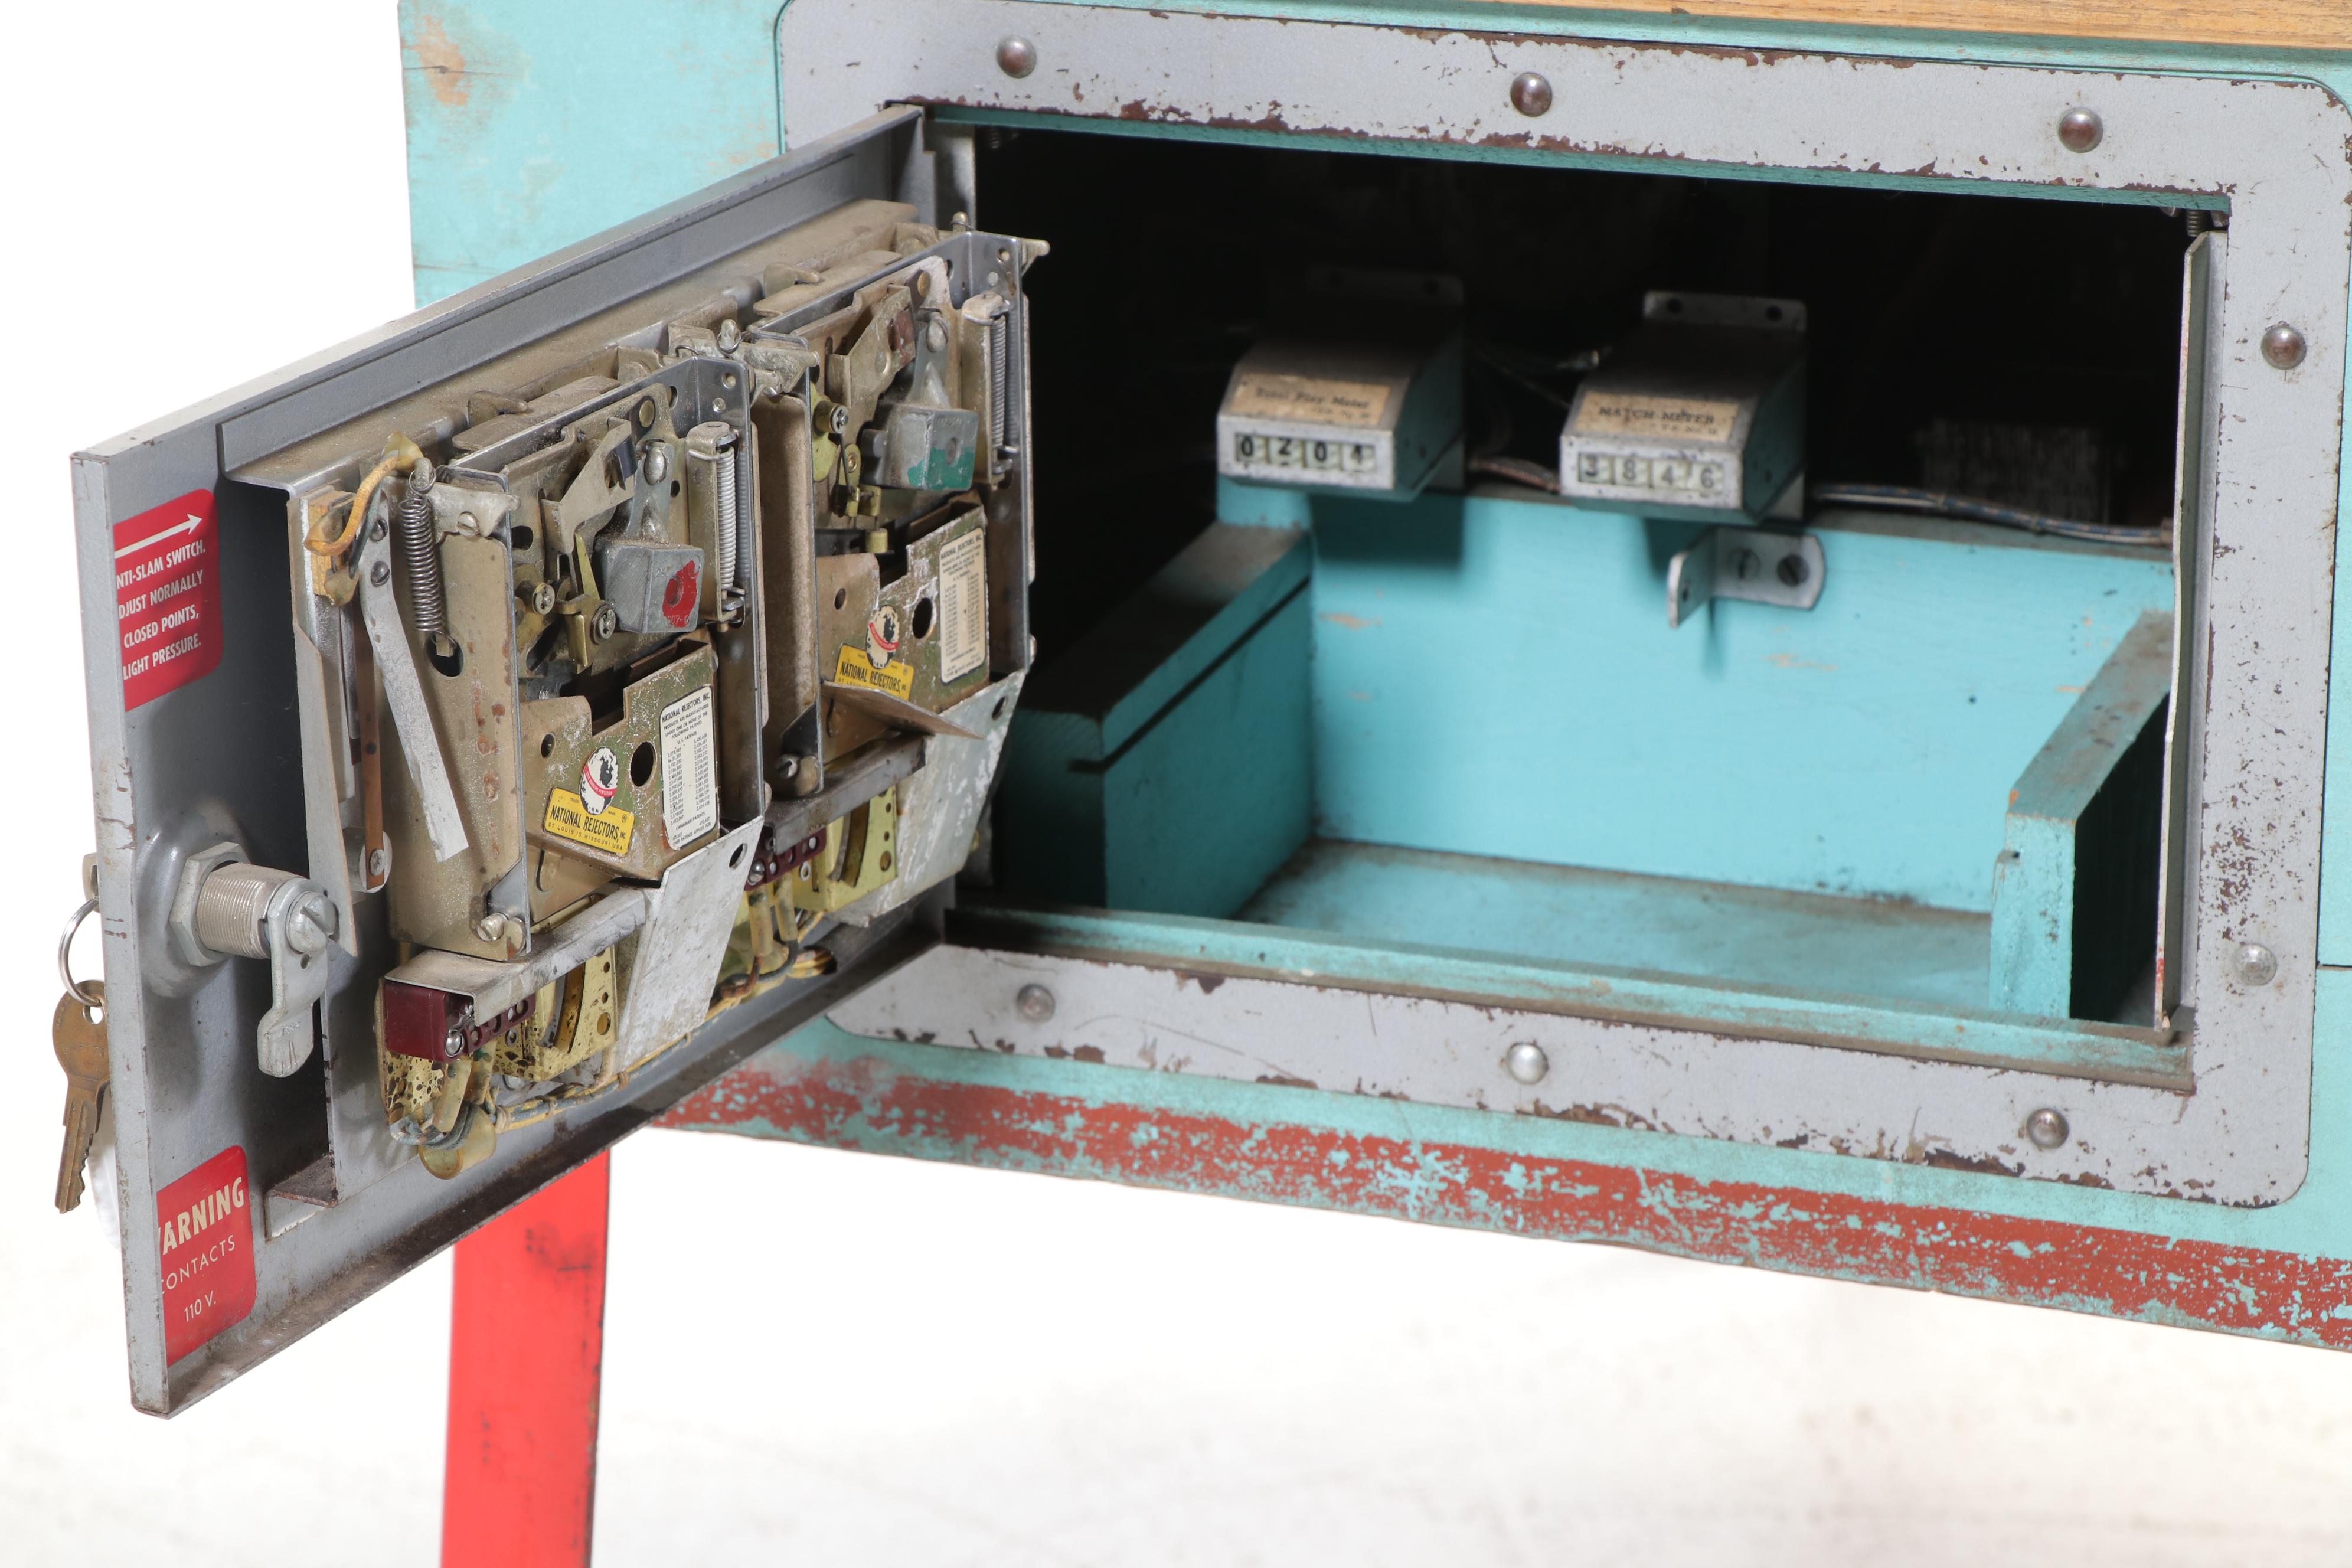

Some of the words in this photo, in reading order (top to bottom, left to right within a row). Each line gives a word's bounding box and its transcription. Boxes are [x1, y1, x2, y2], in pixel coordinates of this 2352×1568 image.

[116, 557, 164, 589] NTI-SLAM
[166, 540, 205, 568] SWITCH.
[119, 594, 146, 619] DJUST
[150, 569, 202, 606] NORMALLY
[124, 622, 158, 648] CLOSED
[162, 605, 198, 632] POINTS,
[123, 656, 149, 680] LIGHT
[152, 633, 201, 667] PRESSURE.
[841, 661, 868, 682] NATIONAL
[870, 671, 901, 694] REJECTORS,
[662, 708, 680, 723] NATIONAL
[682, 697, 702, 712] REJECTORS,
[550, 805, 581, 828] NATIONAL
[583, 816, 619, 843] REJECTORS,
[557, 825, 574, 834] LOUIS
[585, 834, 610, 847] MISSOURI
[158, 1177, 244, 1256] ARNING
[184, 1299, 202, 1322] 110
[205, 1291, 216, 1307] V.
